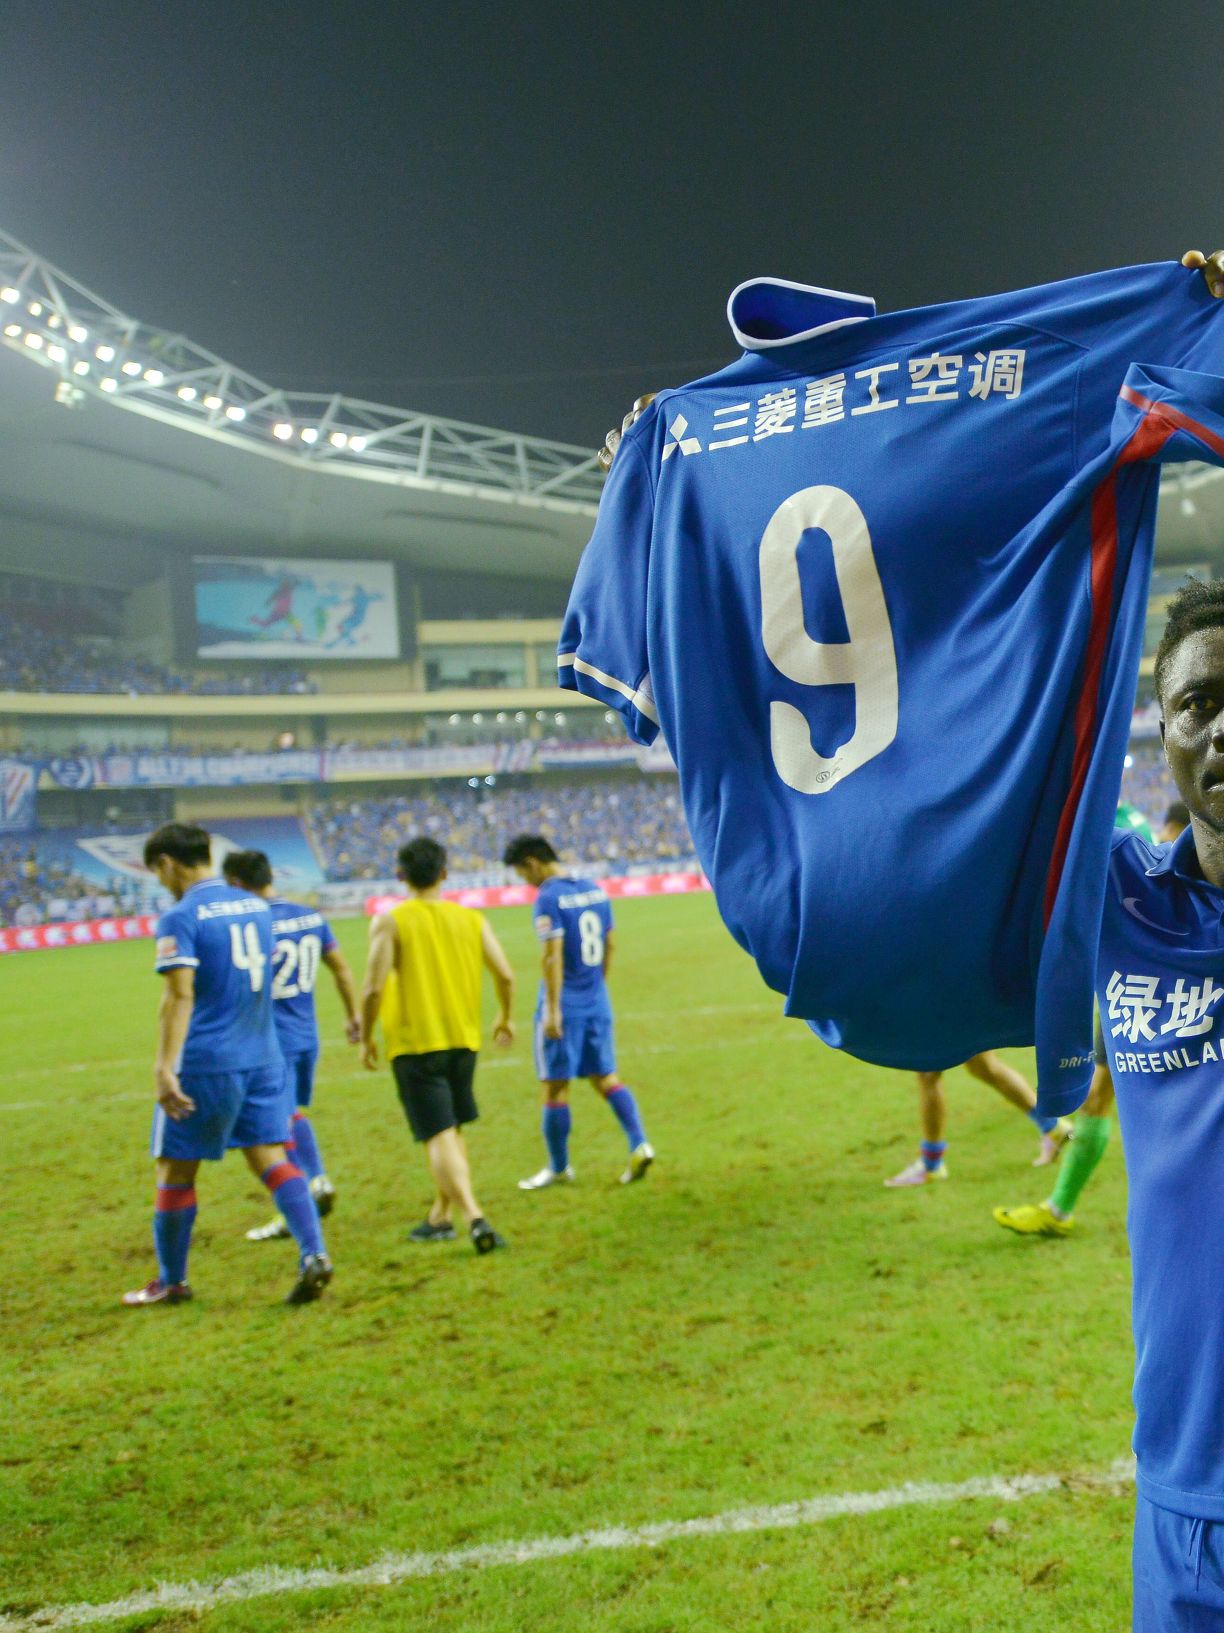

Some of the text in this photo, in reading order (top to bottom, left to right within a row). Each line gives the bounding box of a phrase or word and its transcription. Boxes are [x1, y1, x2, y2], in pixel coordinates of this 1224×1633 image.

[708, 349, 1026, 452] 三菱重工空调
[759, 485, 898, 795] 9
[229, 922, 266, 992] 4
[272, 934, 322, 1000] 20
[579, 910, 604, 967] 8
